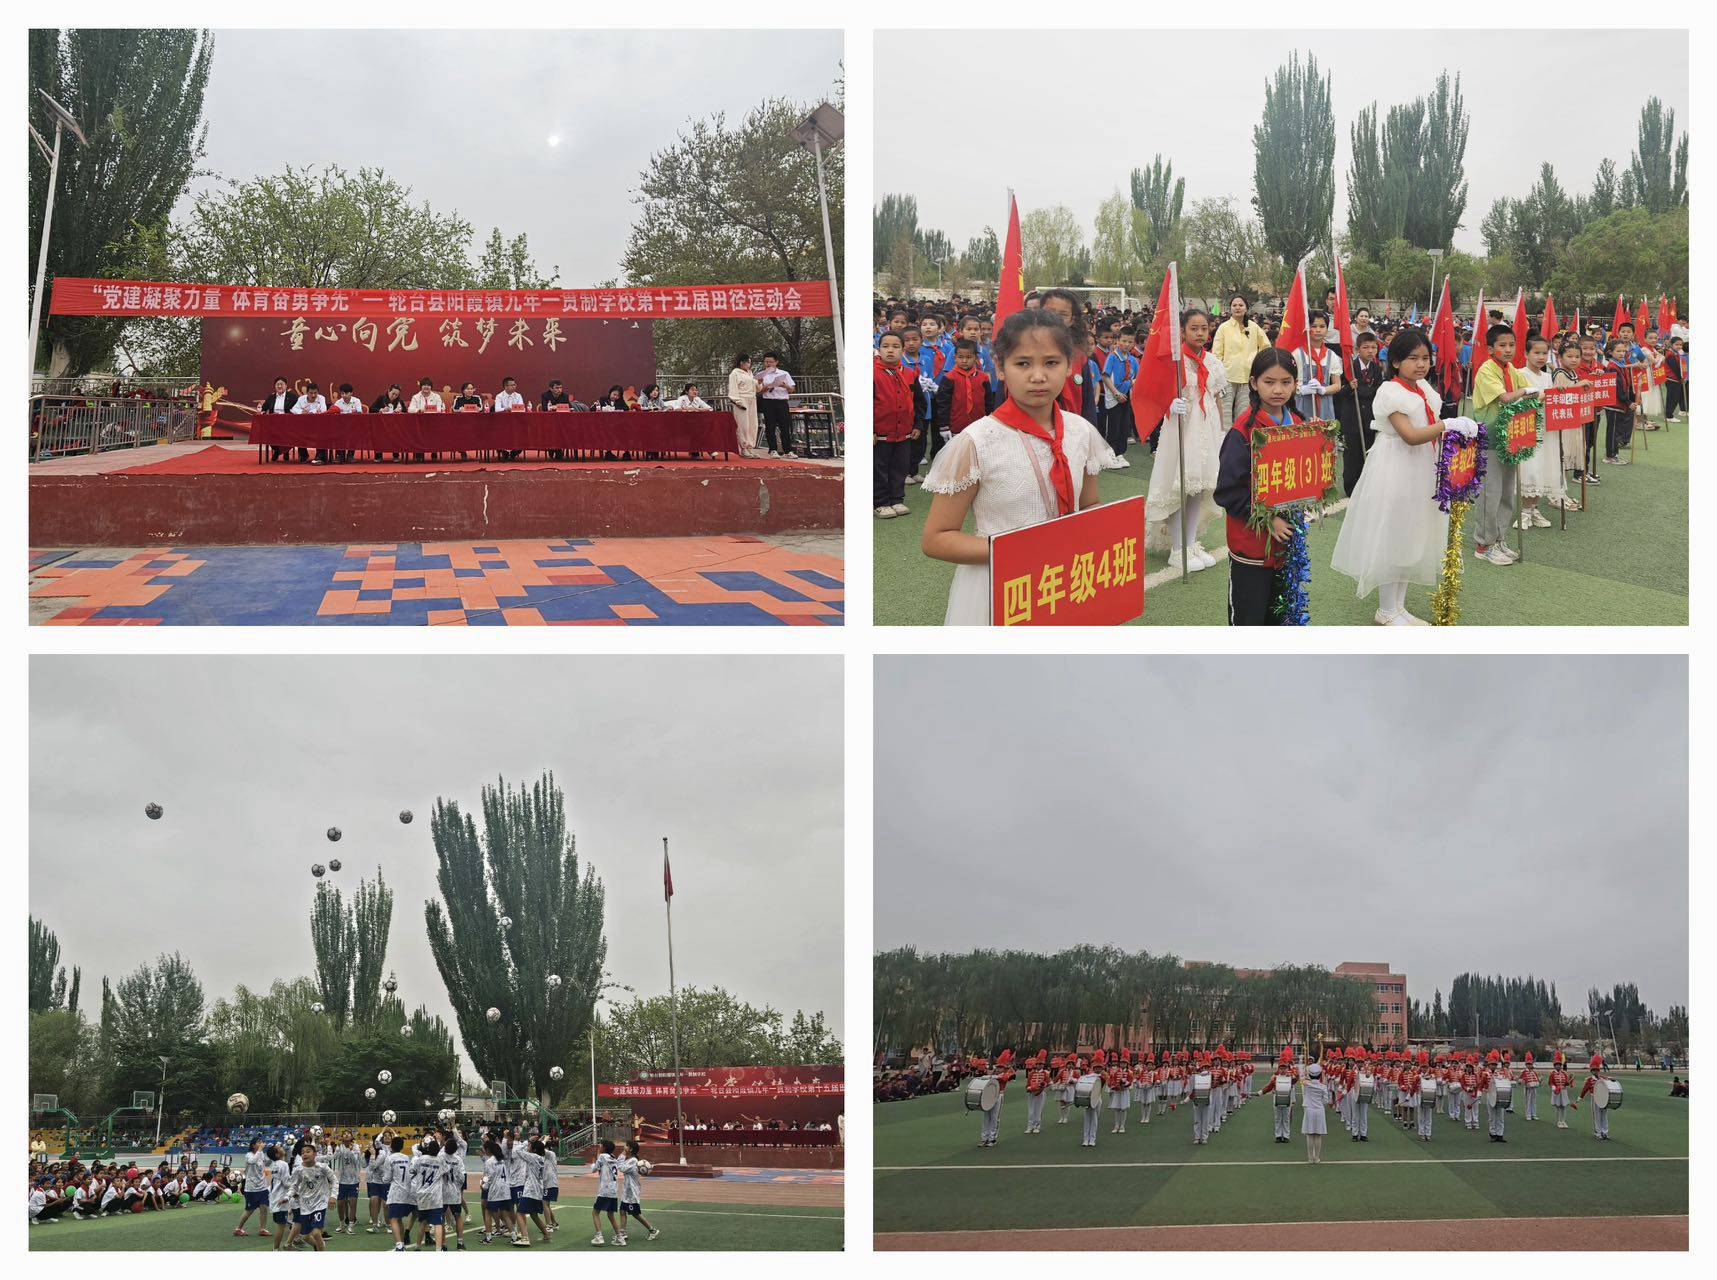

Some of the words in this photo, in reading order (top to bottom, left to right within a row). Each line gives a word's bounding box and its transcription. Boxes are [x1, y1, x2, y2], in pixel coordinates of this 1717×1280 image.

[1003, 537, 1137, 626] 四年级4班
[400, 1166, 406, 1182] 7
[421, 1169, 436, 1187] 14
[314, 1212, 322, 1222] 10
